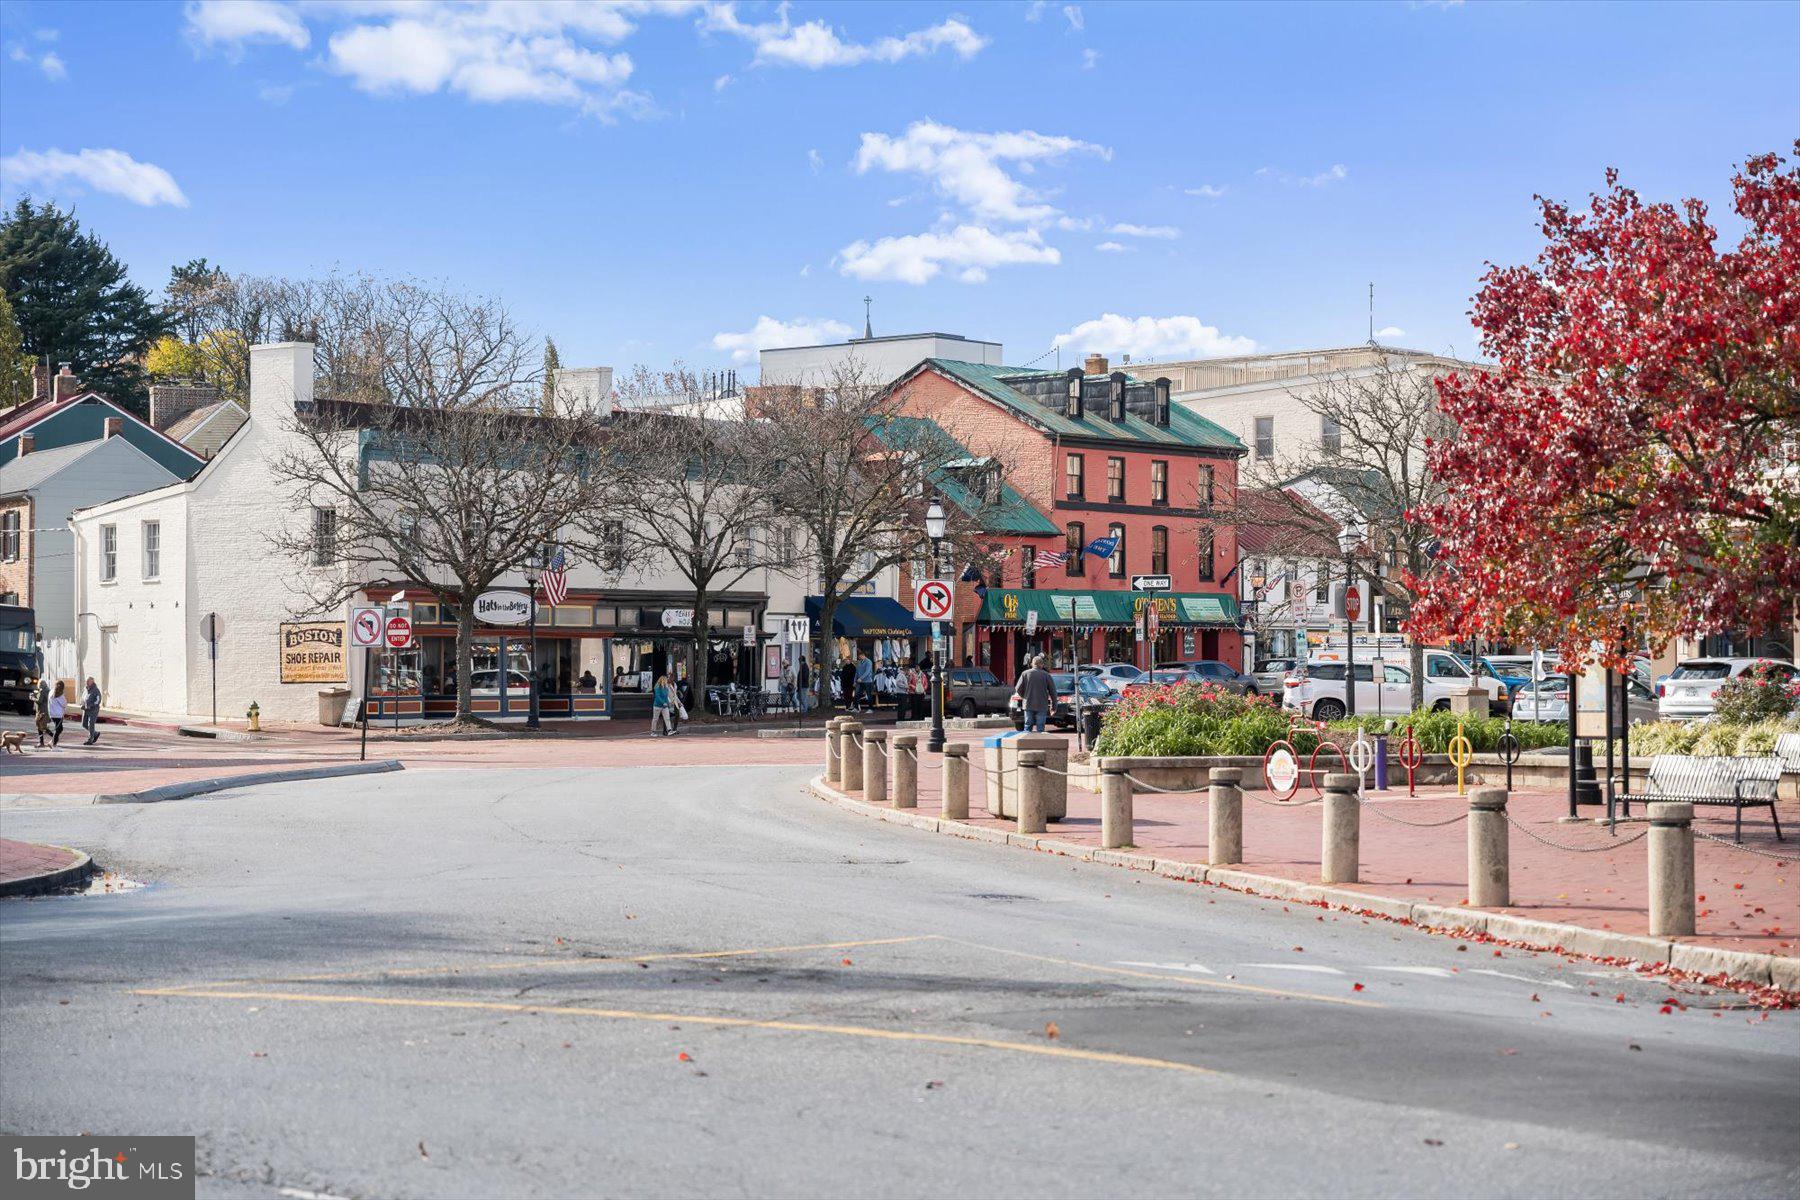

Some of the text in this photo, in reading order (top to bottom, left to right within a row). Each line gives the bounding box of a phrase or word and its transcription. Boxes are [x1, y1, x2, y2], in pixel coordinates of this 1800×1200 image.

[1143, 579, 1168, 587] ONE WAY
[478, 599, 497, 613] Hats
[1346, 597, 1360, 611] STOP
[290, 630, 337, 645] BOSTON
[285, 652, 341, 664] SHOE REPAIR
